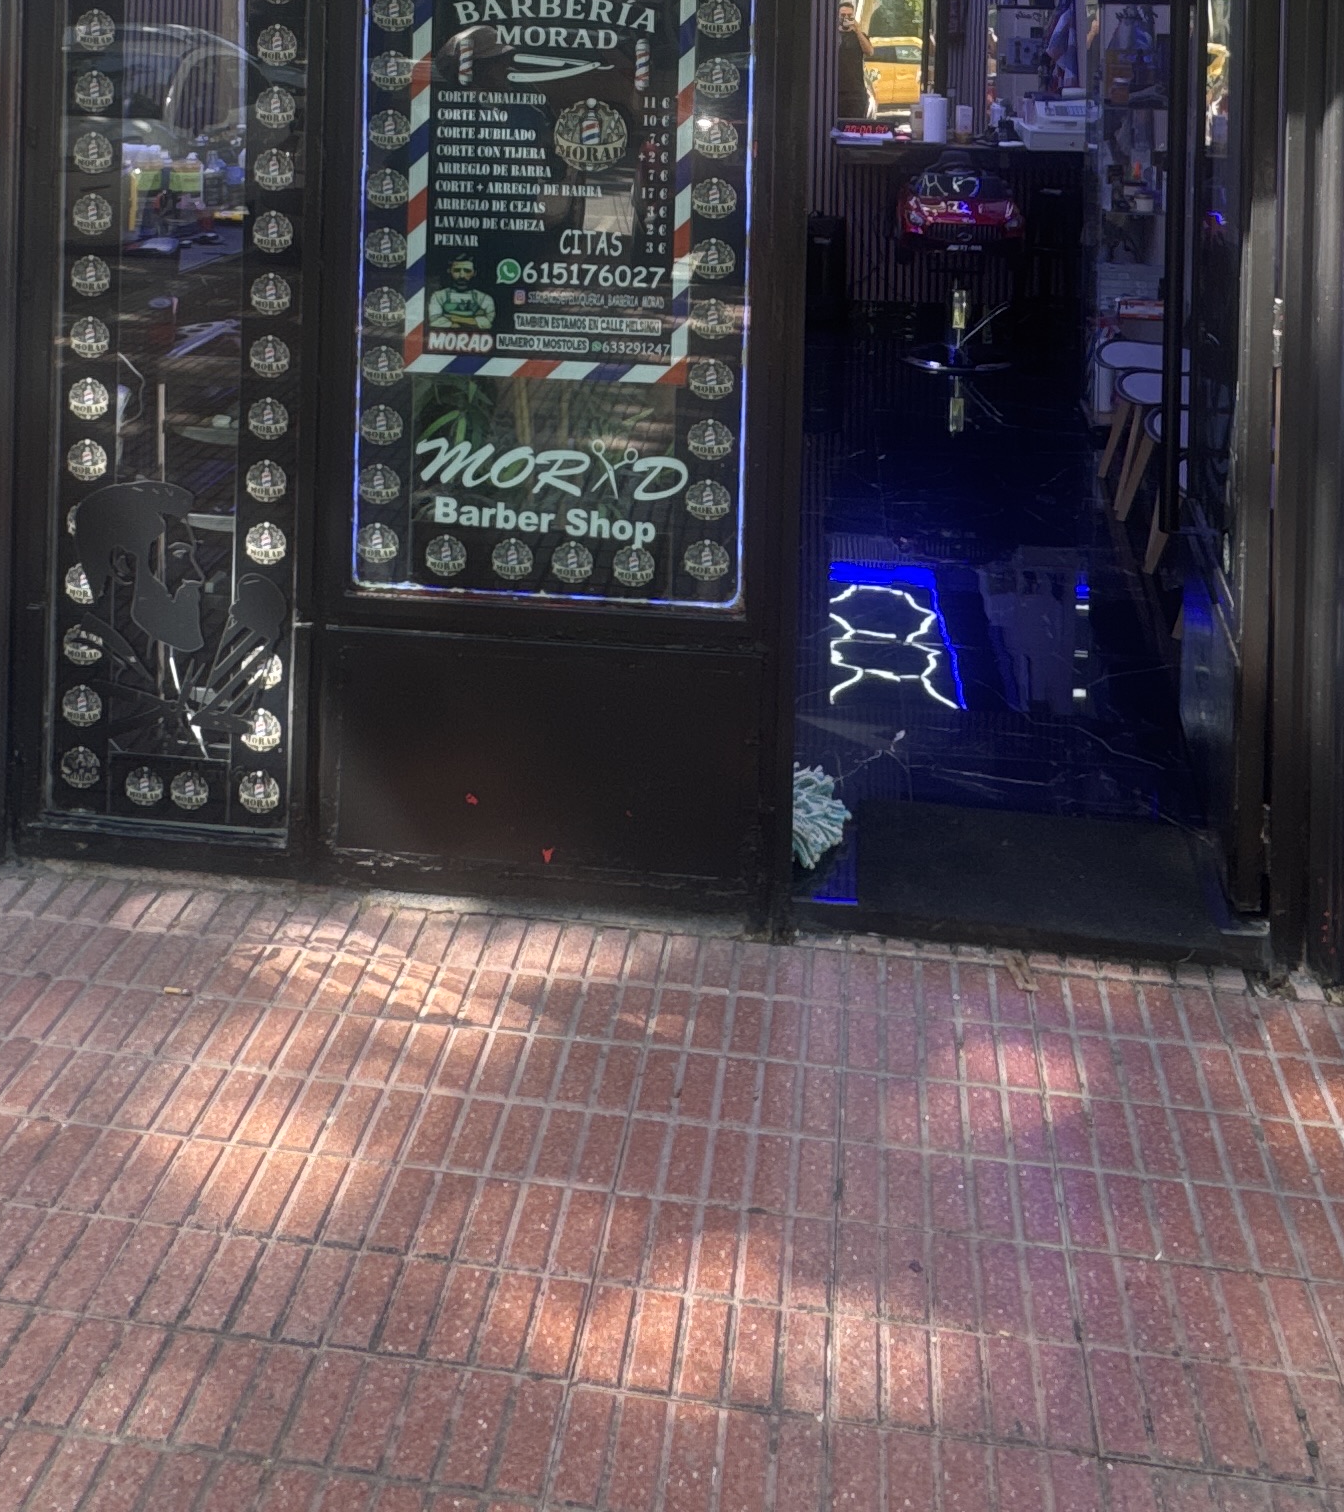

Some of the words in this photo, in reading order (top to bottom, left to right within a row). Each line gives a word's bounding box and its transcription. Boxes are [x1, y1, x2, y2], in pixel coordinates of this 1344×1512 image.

[496, 25, 618, 50] MORAD
[438, 90, 476, 103] CORTE
[479, 91, 546, 105] CABALLERO
[643, 96, 656, 108] 11
[662, 97, 670, 109] €
[437, 108, 476, 121] CORTE
[479, 107, 508, 122] NIÑO
[643, 115, 657, 126] 10
[661, 115, 670, 127] €
[437, 126, 475, 139] CORTE
[478, 127, 536, 141] JUBILADO
[661, 133, 669, 145] €
[436, 144, 475, 157] CORTE
[477, 145, 501, 158] CON
[504, 146, 546, 160] TIJERA
[558, 143, 626, 162] MORAD
[648, 151, 655, 163] 2
[660, 151, 668, 163] €
[436, 162, 490, 176] ARREGLO
[493, 164, 508, 177] DE
[648, 169, 655, 181] 7
[660, 170, 668, 182] €
[435, 180, 474, 193] CORTE
[486, 181, 540, 195] ARREGLO
[544, 183, 559, 196] DE
[642, 187, 654, 199] 17
[660, 188, 667, 200] €
[434, 198, 489, 211] ARREGLO
[492, 199, 507, 212] DE
[510, 200, 546, 214] CEJAS
[659, 206, 667, 218] €
[434, 215, 480, 229] LAVADO
[482, 217, 498, 230] DE
[500, 217, 545, 232] CABEZA
[659, 224, 666, 236] €
[434, 233, 479, 247] PEINAR
[559, 229, 623, 257] CITAS
[646, 242, 654, 253] 3
[658, 242, 666, 254] €
[522, 261, 666, 288] 615176027
[516, 315, 550, 328] TAMBIEN
[551, 317, 586, 330] ESTAMOS
[588, 319, 598, 331] EN
[600, 319, 624, 332] CALLE
[427, 333, 493, 353] MORAD
[498, 336, 534, 348] NUMERO
[543, 338, 587, 351] MOSTOLES
[602, 341, 670, 357] 633291247
[435, 496, 555, 533] Barber
[565, 508, 655, 549] Shop
